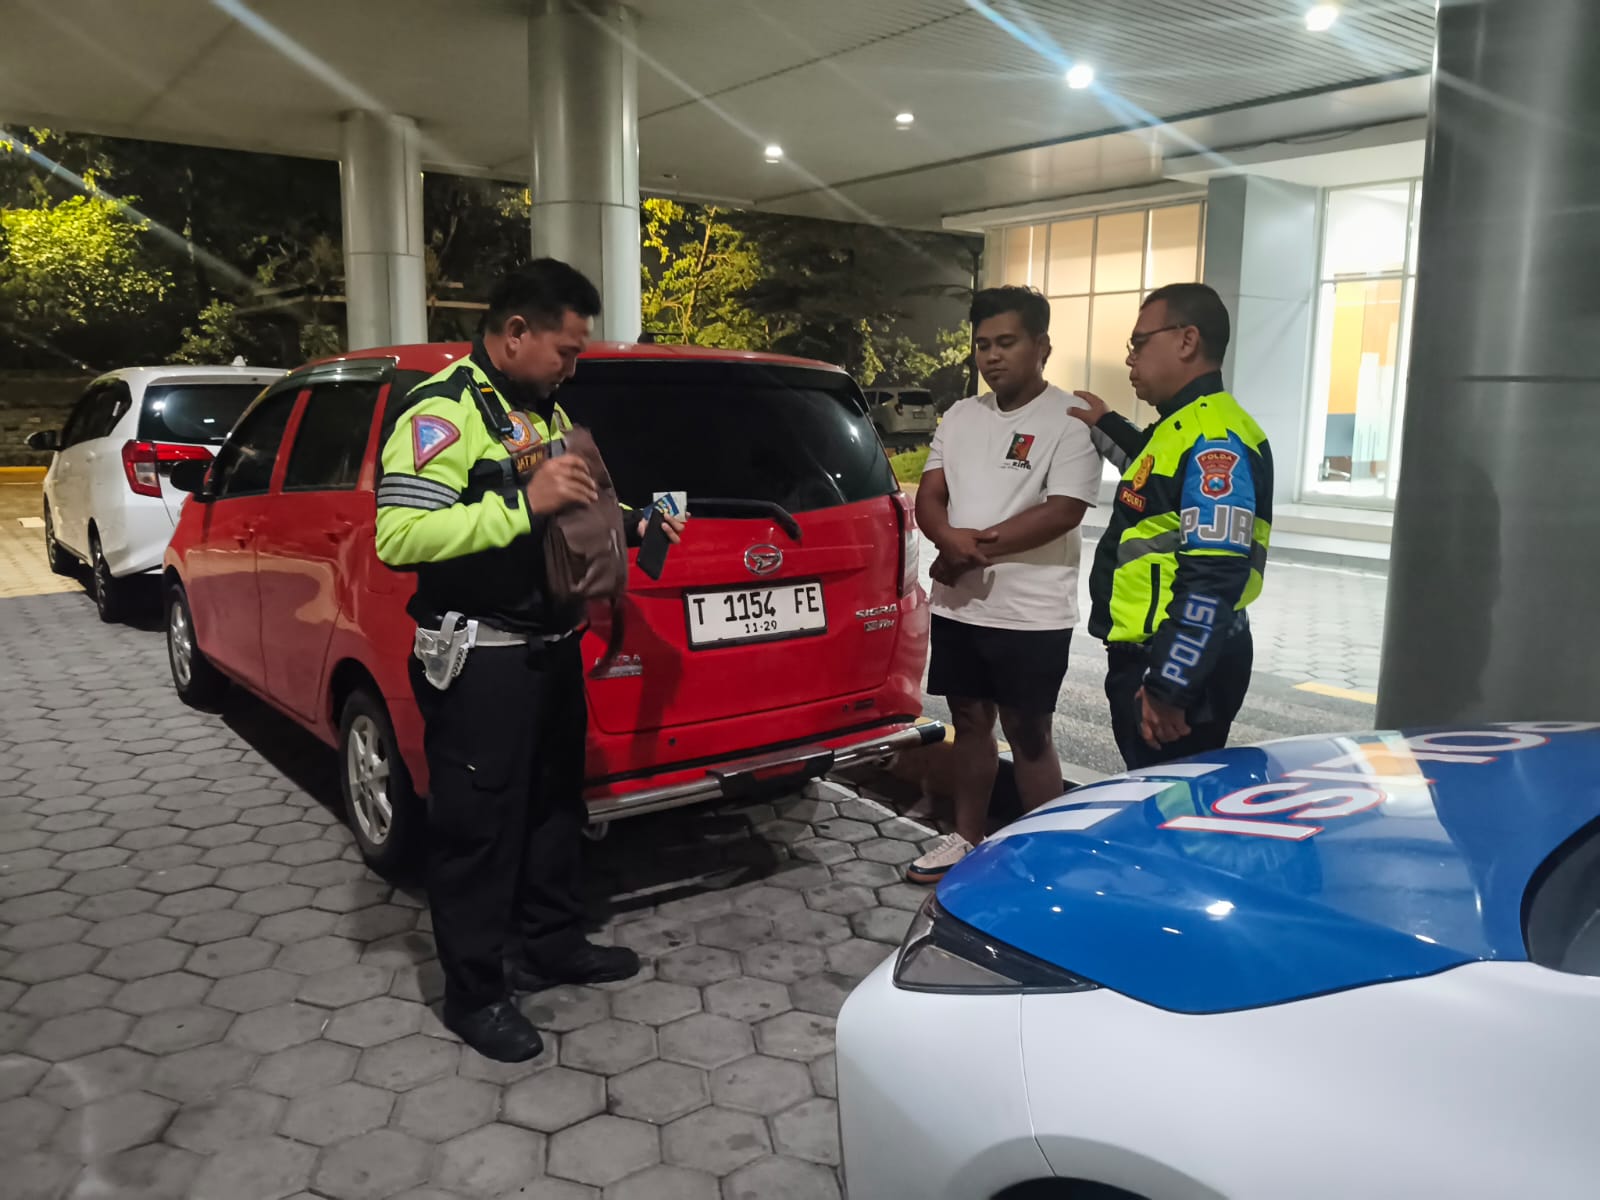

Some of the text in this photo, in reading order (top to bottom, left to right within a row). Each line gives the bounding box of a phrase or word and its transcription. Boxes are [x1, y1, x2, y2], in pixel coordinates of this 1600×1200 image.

[1200, 453, 1233, 462] POLDA
[1122, 489, 1144, 508] POLRI
[1179, 504, 1255, 548] PJR
[693, 587, 819, 625] T 1154 FE
[855, 603, 897, 618] SIGRA
[1160, 593, 1220, 687] POLISI
